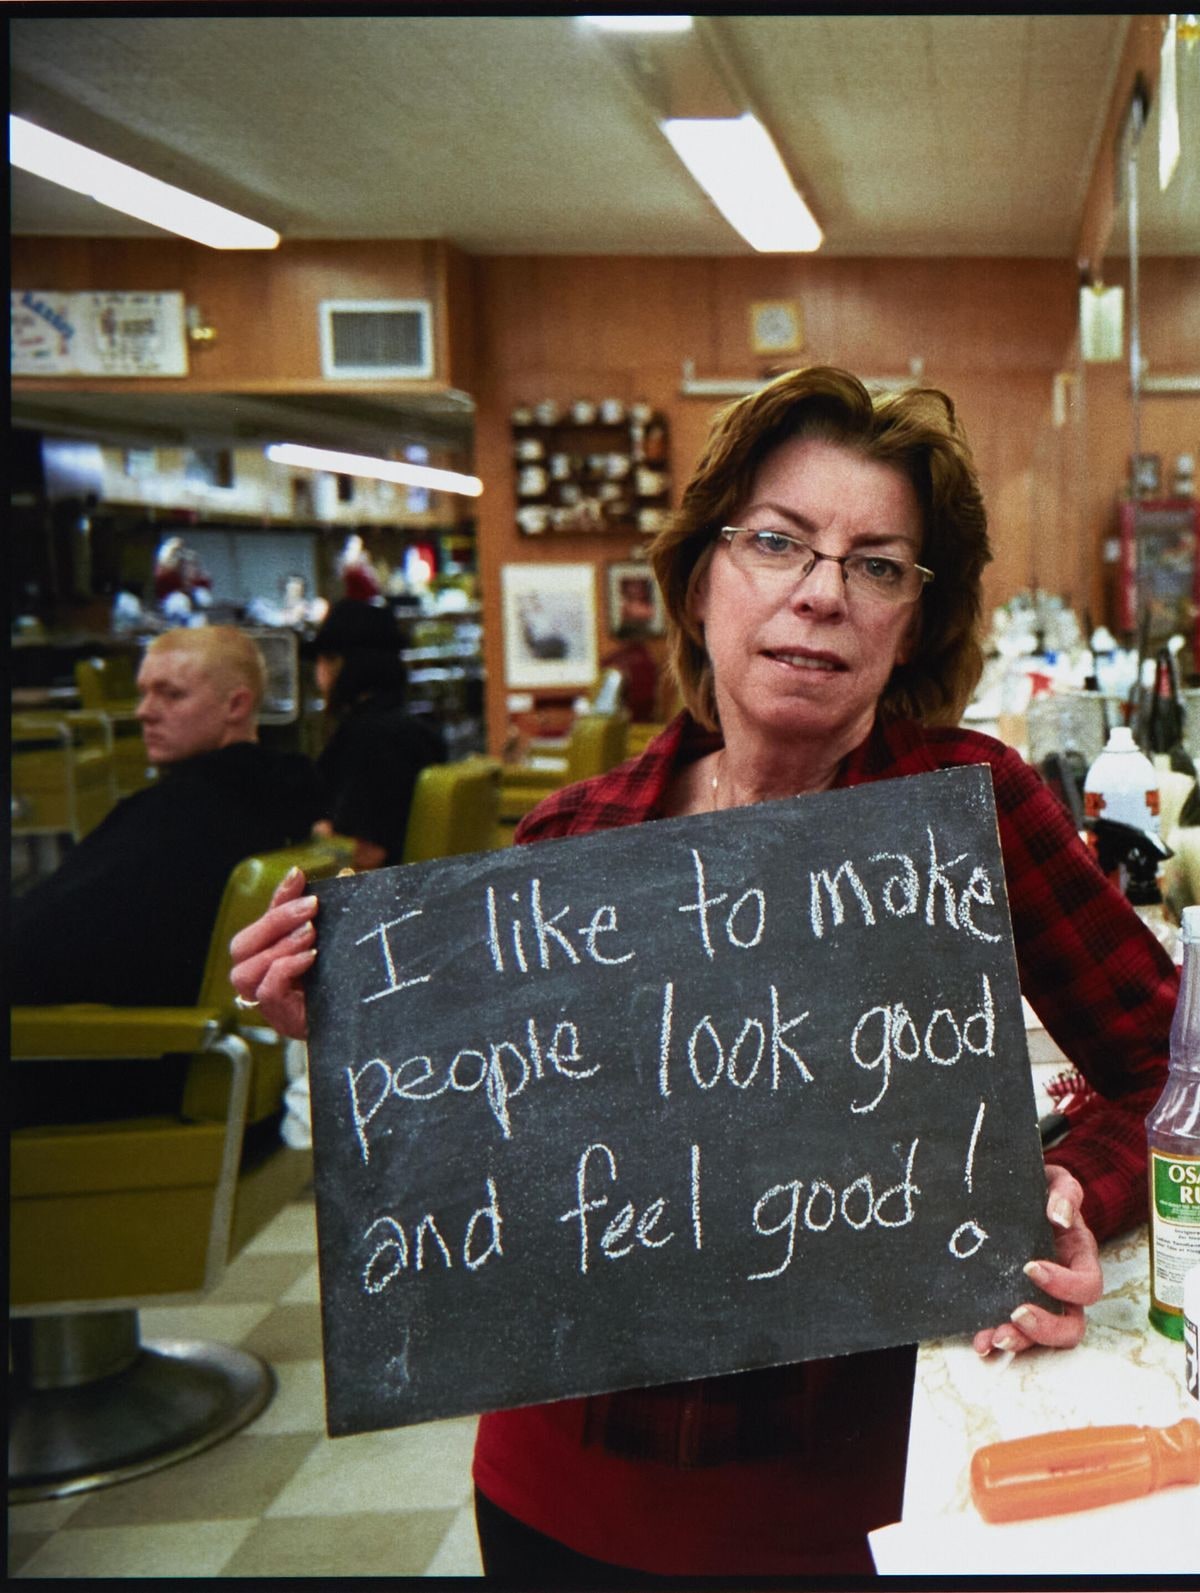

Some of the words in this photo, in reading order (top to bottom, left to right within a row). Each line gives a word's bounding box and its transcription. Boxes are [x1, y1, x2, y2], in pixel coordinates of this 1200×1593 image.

[355, 910, 431, 1002] I
[487, 879, 635, 972] like
[679, 849, 765, 959] to
[810, 824, 1002, 943] make
[348, 1019, 602, 1164] people
[659, 982, 814, 1097] look
[851, 973, 995, 1114] good
[363, 1177, 503, 1294] and
[560, 1144, 701, 1274] feel
